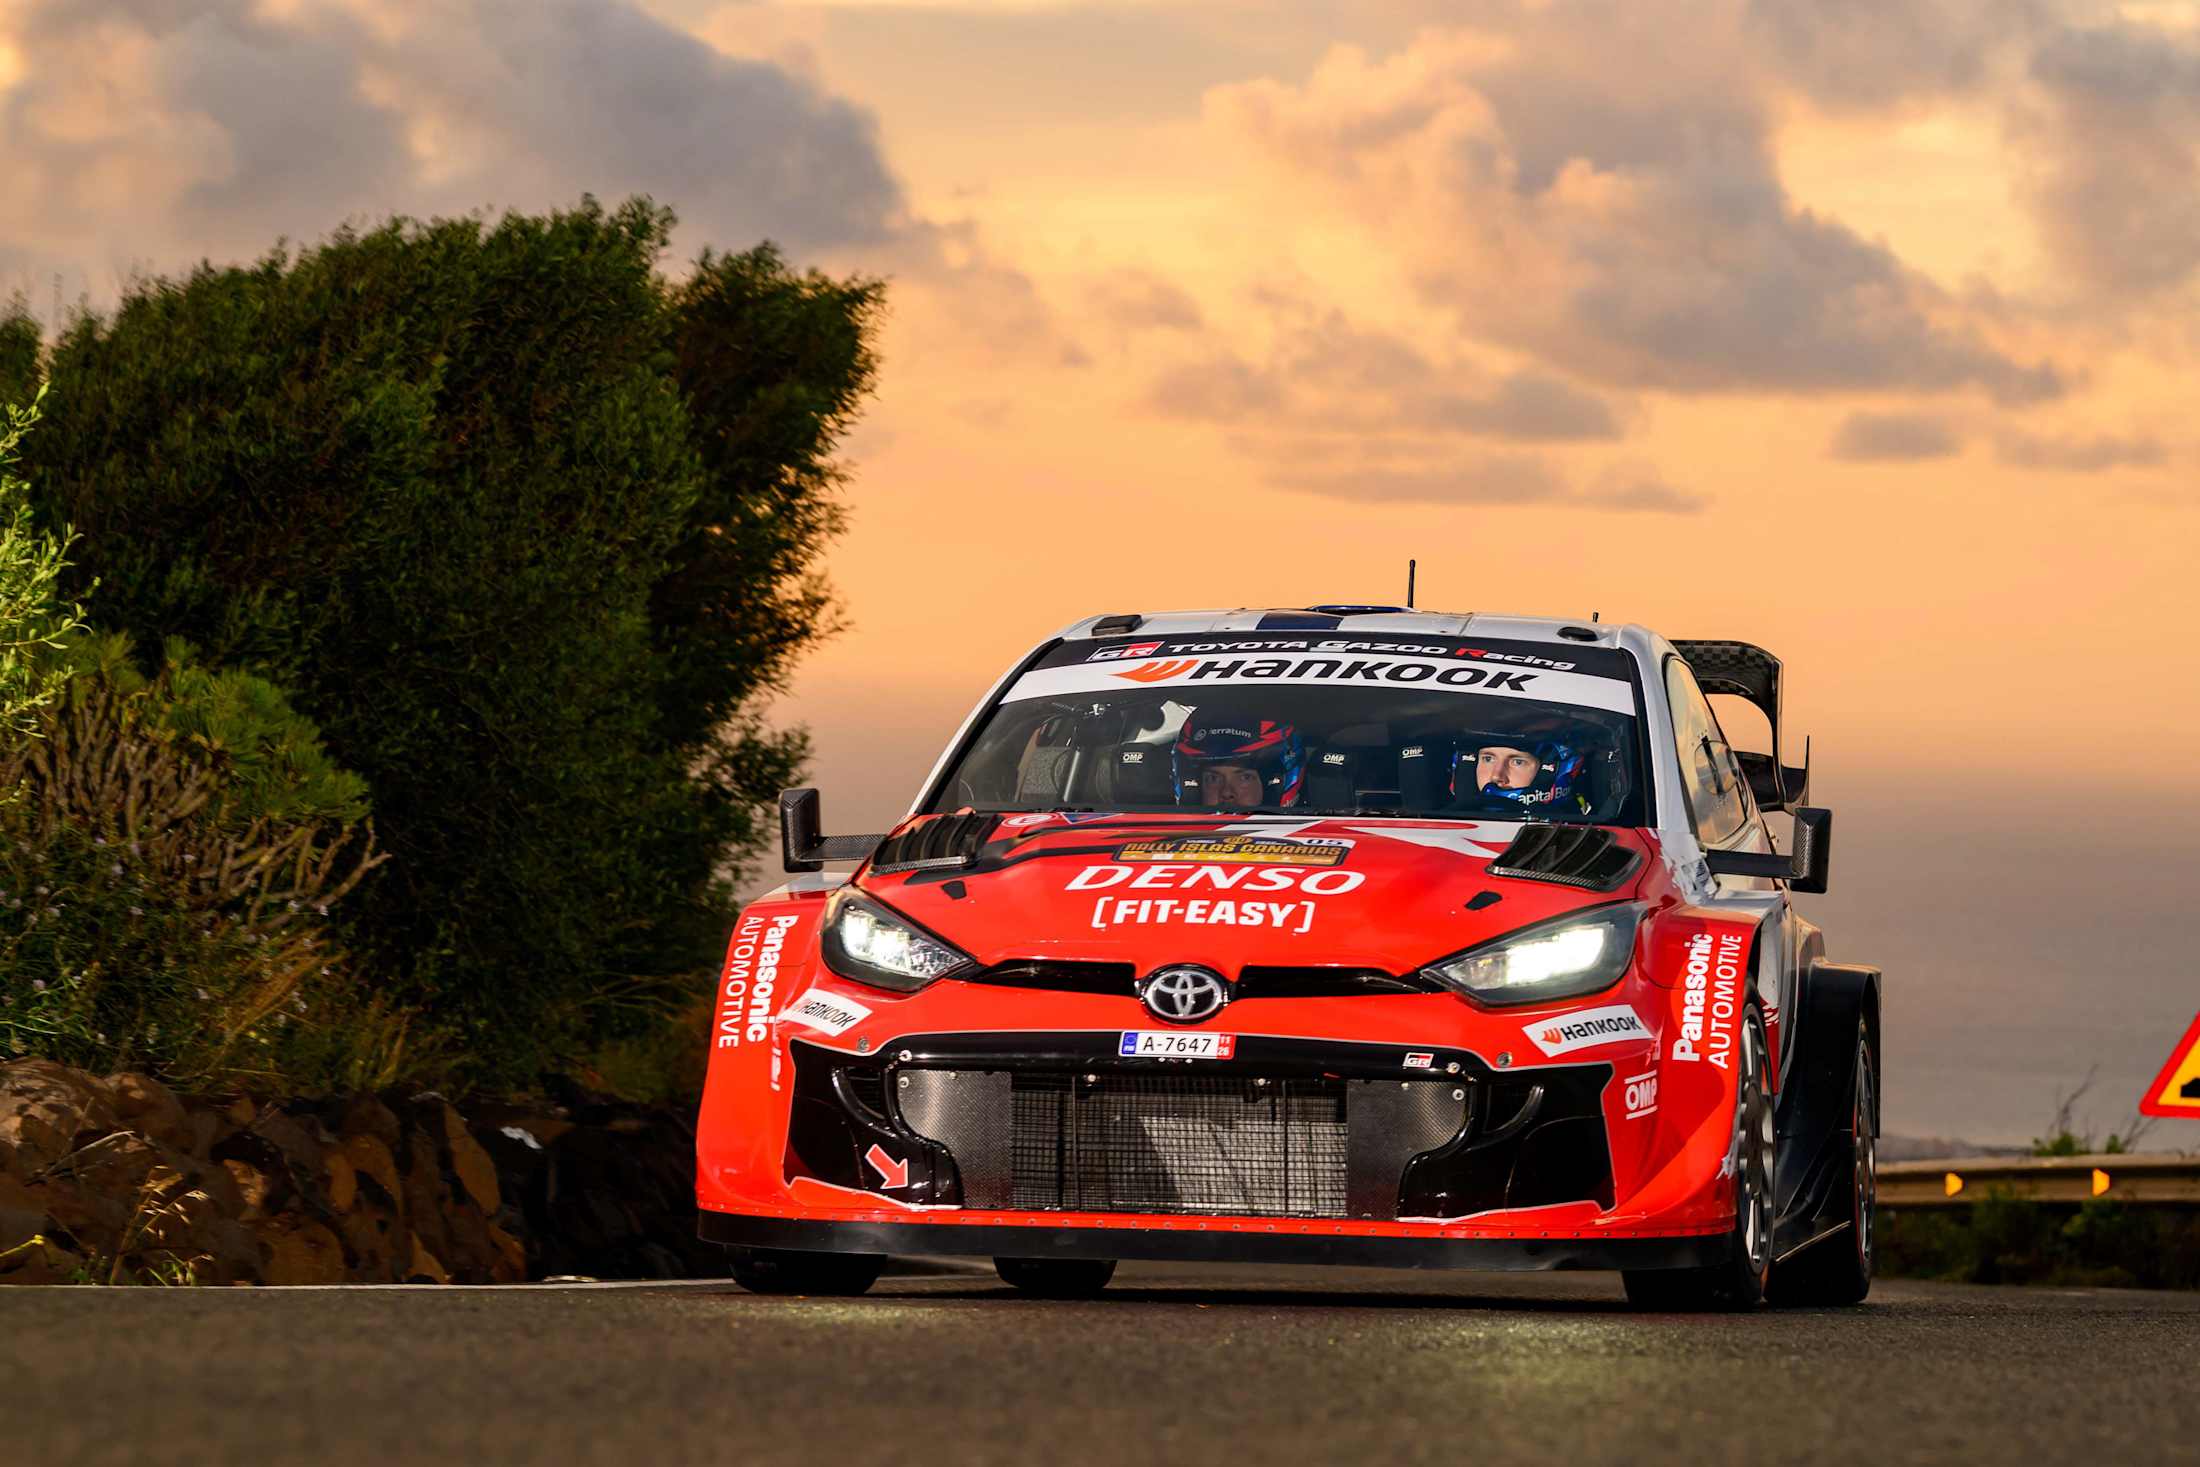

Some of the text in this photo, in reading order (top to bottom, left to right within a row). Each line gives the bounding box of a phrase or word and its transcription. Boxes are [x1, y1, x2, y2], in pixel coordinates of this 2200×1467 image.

[1090, 640, 1577, 671] GR TOYOTA GAZOO Racing
[1189, 659, 1539, 692] HANKOOK
[1122, 753, 1144, 762] OMP
[1322, 753, 1345, 763] OMP
[1402, 747, 1423, 757] OMP
[1124, 842, 1343, 856] RALLY ISLAS CANARIAS
[1306, 838, 1344, 846] 05
[1064, 865, 1366, 895] DENSO
[719, 916, 765, 1048] AUTOMOTIVE
[746, 915, 799, 1042] Panasonic
[1672, 933, 1713, 1062] Panasonic
[1708, 934, 1742, 1069] AUTOMOTIVE
[1560, 1016, 1642, 1041] HANKOOK
[1143, 1036, 1211, 1053] A-7647
[1407, 1056, 1432, 1067] GR
[1625, 1077, 1658, 1111] OMP
